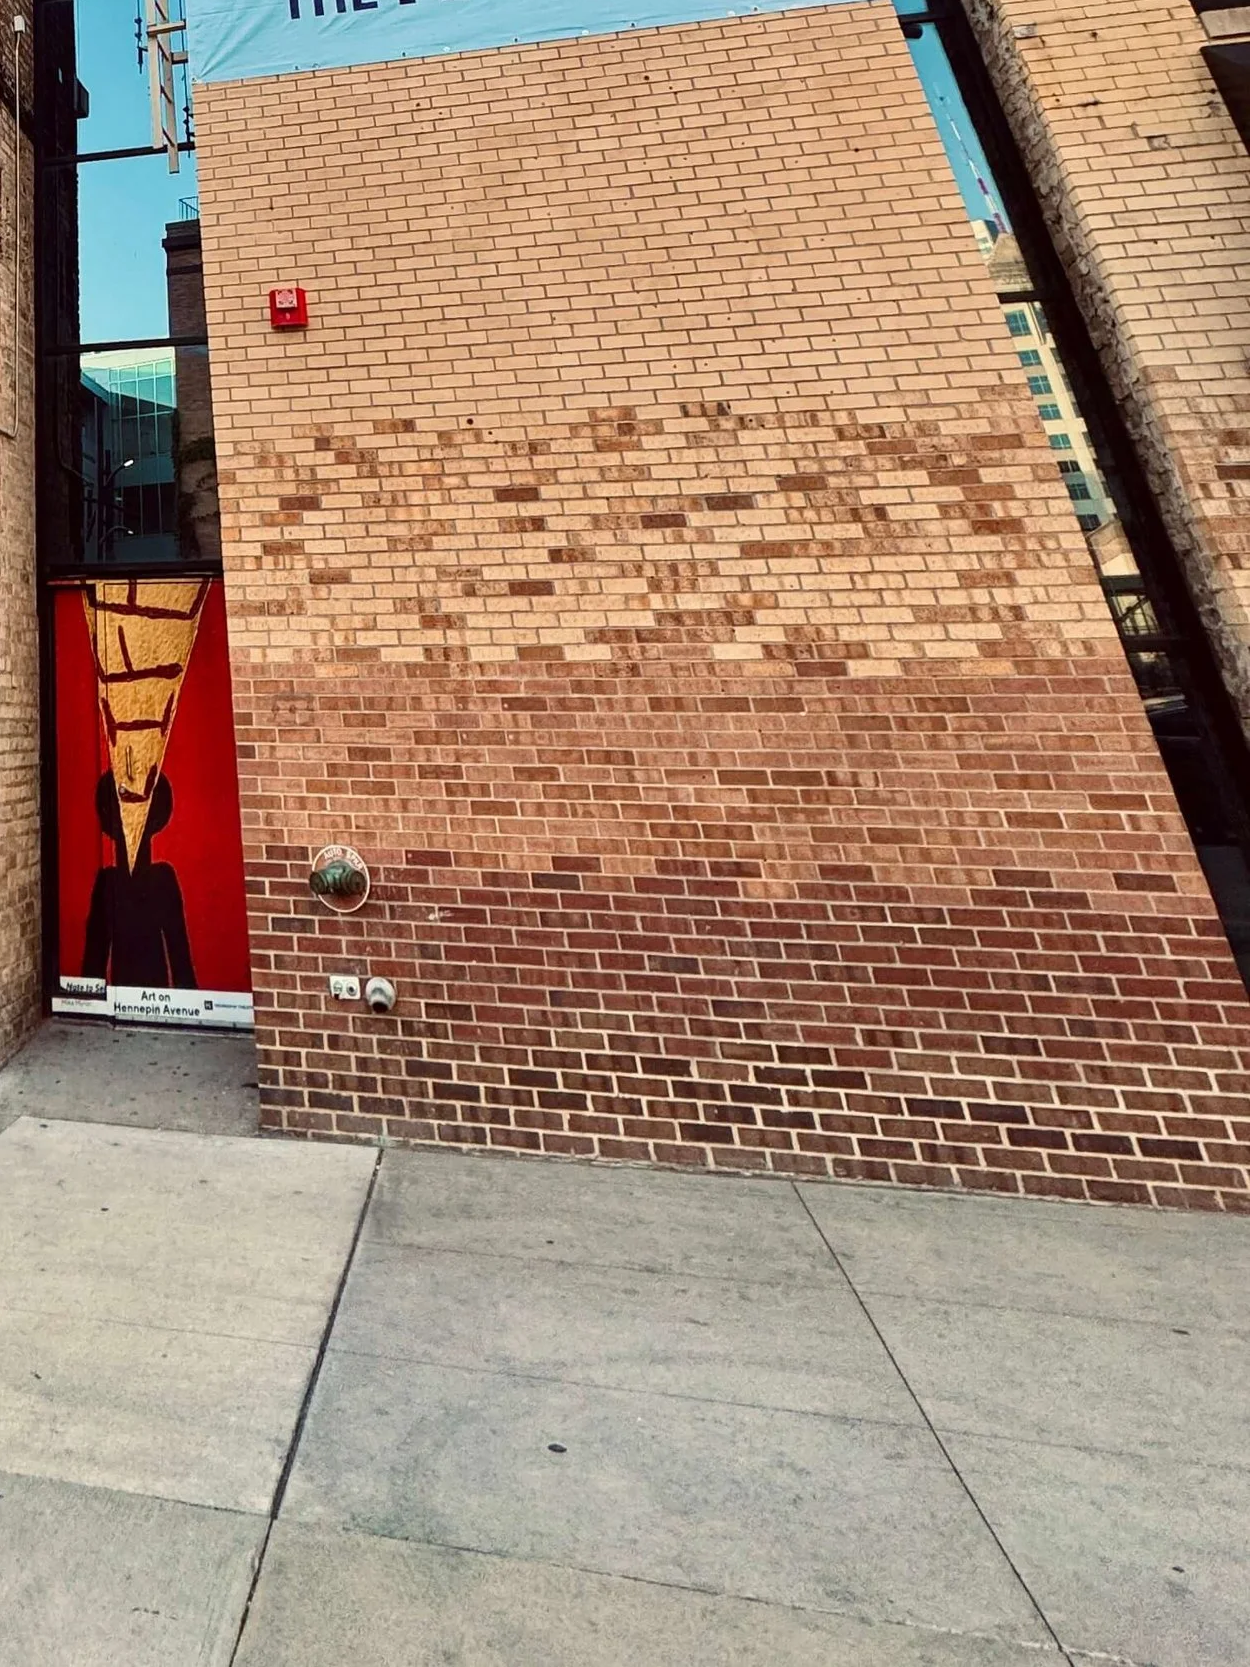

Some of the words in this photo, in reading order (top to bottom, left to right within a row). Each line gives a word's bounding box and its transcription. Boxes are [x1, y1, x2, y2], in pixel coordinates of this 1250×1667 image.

[324, 848, 342, 860] AUTO
[66, 982, 84, 993] Note
[141, 991, 156, 1002] Art
[159, 993, 171, 1002] on
[114, 1002, 161, 1015] Hennepin
[163, 1005, 200, 1017] Avenue
